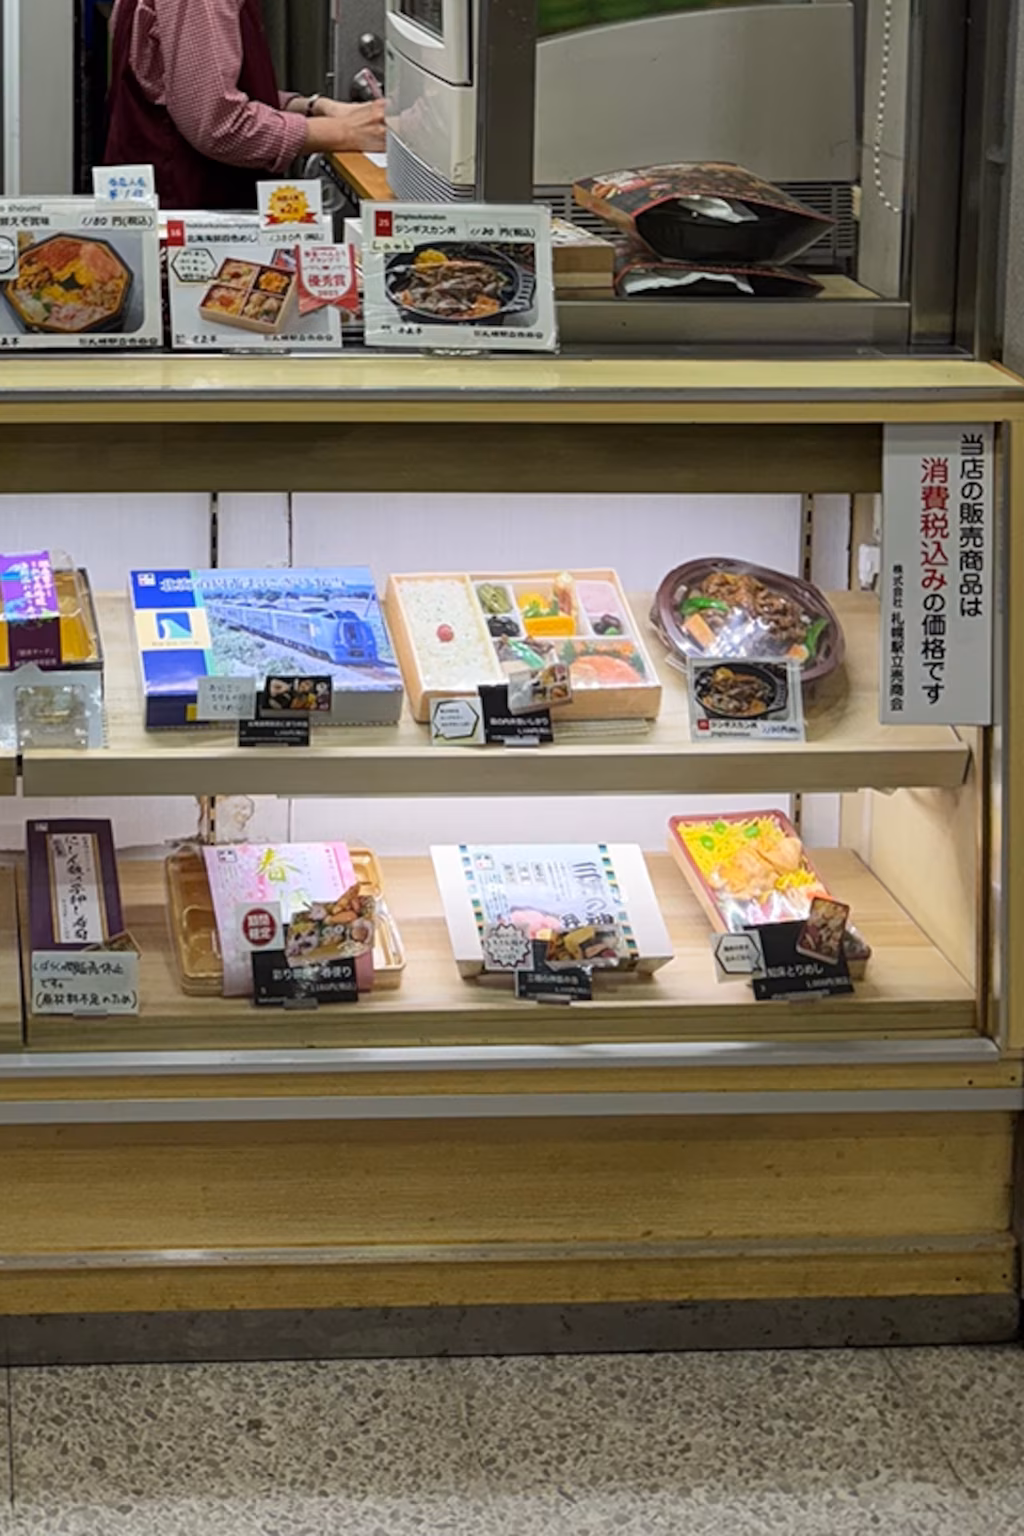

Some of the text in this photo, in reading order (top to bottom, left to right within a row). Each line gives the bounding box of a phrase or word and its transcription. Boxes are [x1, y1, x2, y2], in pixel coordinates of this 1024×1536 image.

[308, 274, 346, 287] 優秀賞
[920, 457, 950, 705] 消費税込みの価格です
[959, 433, 985, 617] 当店の販売商品は
